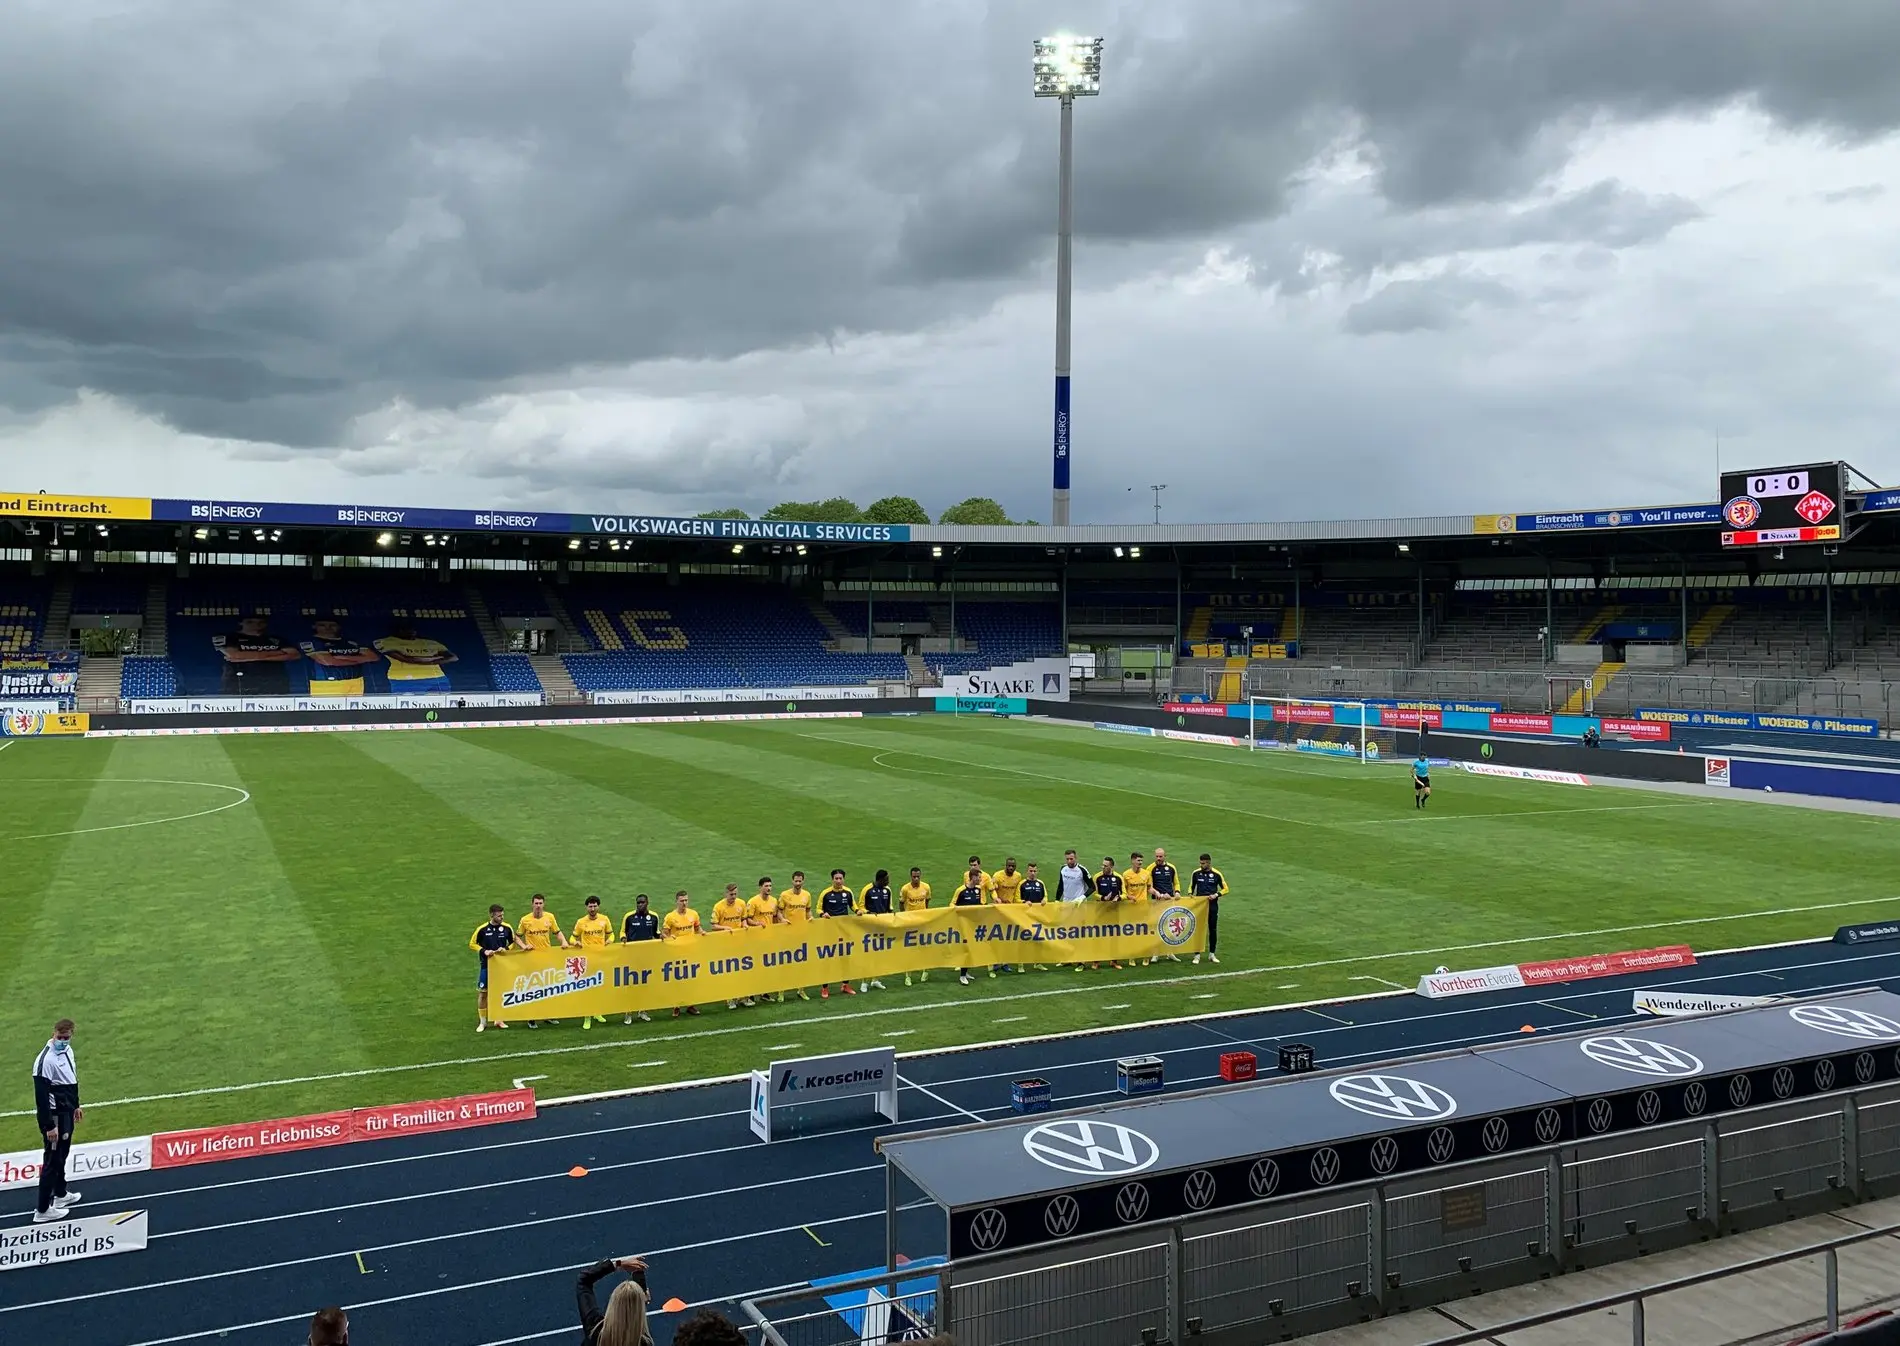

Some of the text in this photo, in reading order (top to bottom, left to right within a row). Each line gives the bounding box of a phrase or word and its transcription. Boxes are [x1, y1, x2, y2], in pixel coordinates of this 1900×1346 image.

[1754, 478, 1767, 493] 0
[1787, 475, 1800, 491] 0
[27, 499, 113, 515] Eintracht.
[1535, 513, 1584, 524] Eintracht
[1535, 522, 1585, 531] BRAUNSCHWEIG
[591, 516, 891, 541] VOLKSWAGEN FINANCIAL SERVICES
[2, 675, 44, 687] Unser
[968, 675, 1035, 694] STAAKE
[1493, 717, 1508, 725] DAS
[1604, 722, 1619, 731] DAS
[1703, 713, 1750, 726] Pilsener
[1824, 720, 1873, 734] Pilsener
[613, 966, 652, 987] Ihr
[661, 960, 701, 982] für
[709, 954, 754, 975] uns
[763, 943, 808, 968] und
[816, 935, 856, 959] wir
[861, 932, 897, 954] für
[903, 925, 968, 949] Euch.
[974, 918, 1156, 943] #AlleZusammen.
[1622, 951, 1683, 968] Eventausstattung
[514, 966, 568, 992] #Alle
[1524, 967, 1553, 980] Verleih
[1553, 968, 1568, 978] von
[1592, 960, 1607, 972] und
[503, 971, 602, 1007] Zusammen!
[1429, 970, 1520, 994] Northern Events
[365, 1097, 525, 1131] für Familien & Firmen
[166, 1120, 342, 1158] Wir liefern Erlebnisse
[73, 1148, 142, 1174] Events
[55, 1239, 88, 1258] und
[94, 1235, 115, 1251] BS
